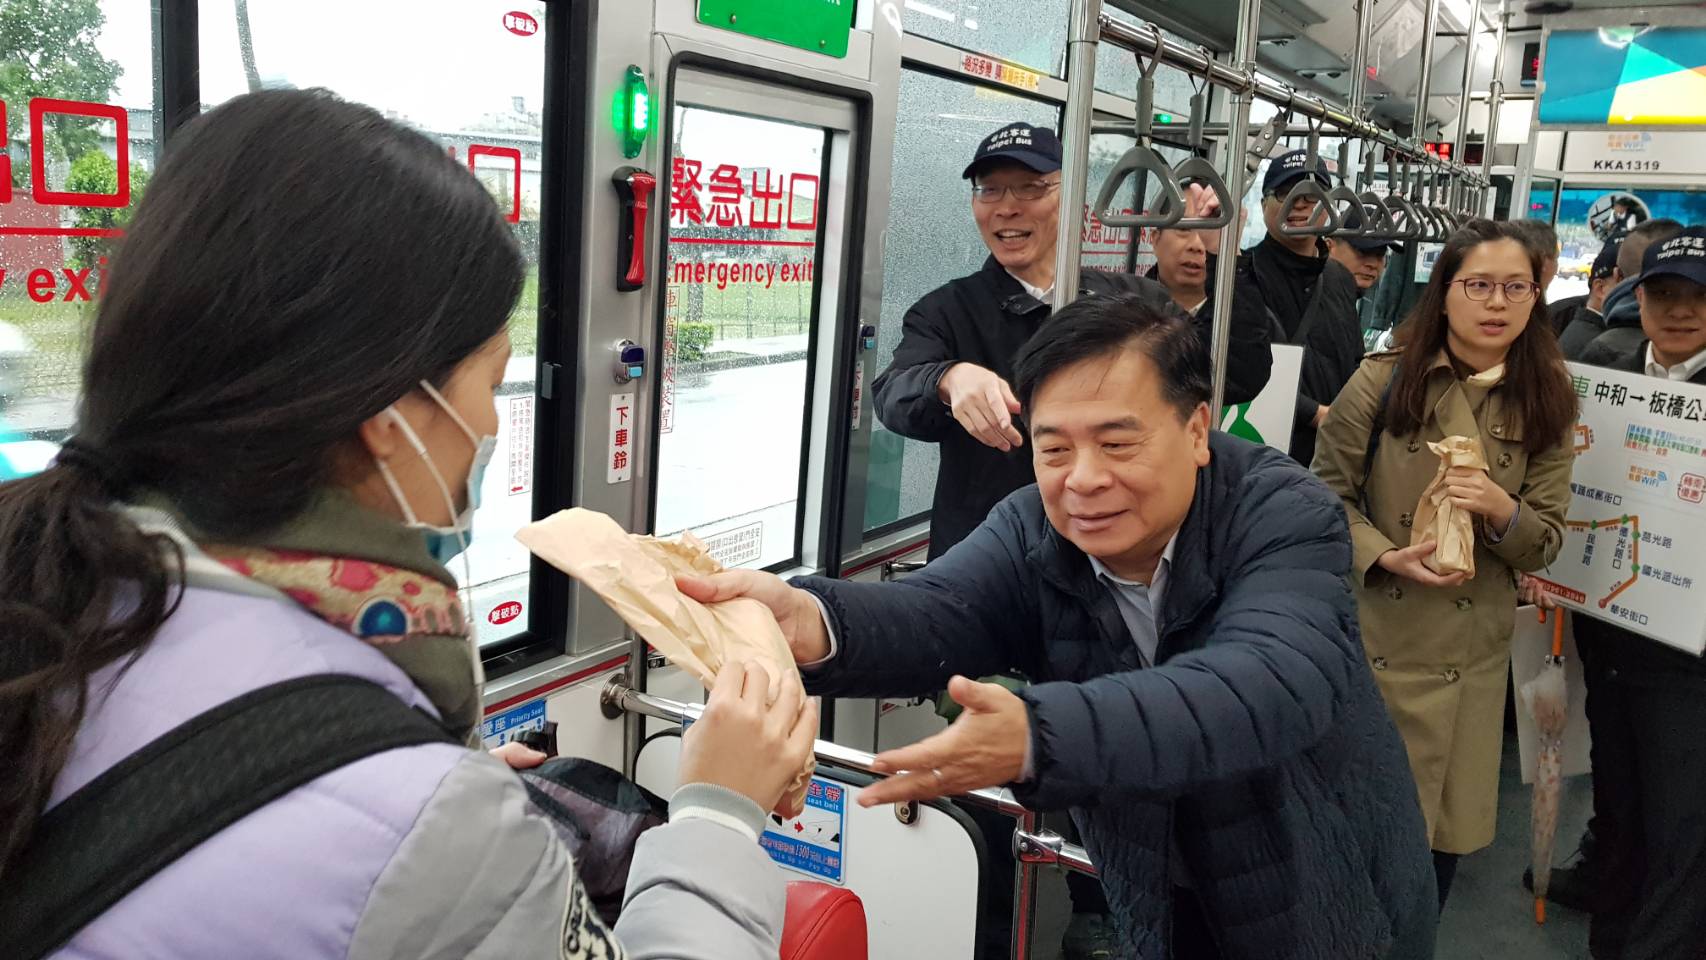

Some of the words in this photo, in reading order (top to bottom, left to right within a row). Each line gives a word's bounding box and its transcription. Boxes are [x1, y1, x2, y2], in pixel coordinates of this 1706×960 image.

[0, 97, 130, 208] 口
[987, 138, 1014, 151] Taipei
[1016, 138, 1032, 146] Bus
[1593, 160, 1660, 170] KKA1319
[670, 157, 819, 230] 緊急出口
[1657, 249, 1684, 260] Taipei
[781, 257, 813, 282] exit
[1594, 381, 1628, 408] 中和
[1649, 390, 1706, 423] 板橋公
[613, 406, 629, 470] 下車鈴
[491, 604, 520, 623] 擊破點
[511, 712, 531, 725] Priority
[531, 707, 543, 717] Seat
[807, 796, 822, 806] seat
[824, 800, 839, 811] belt
